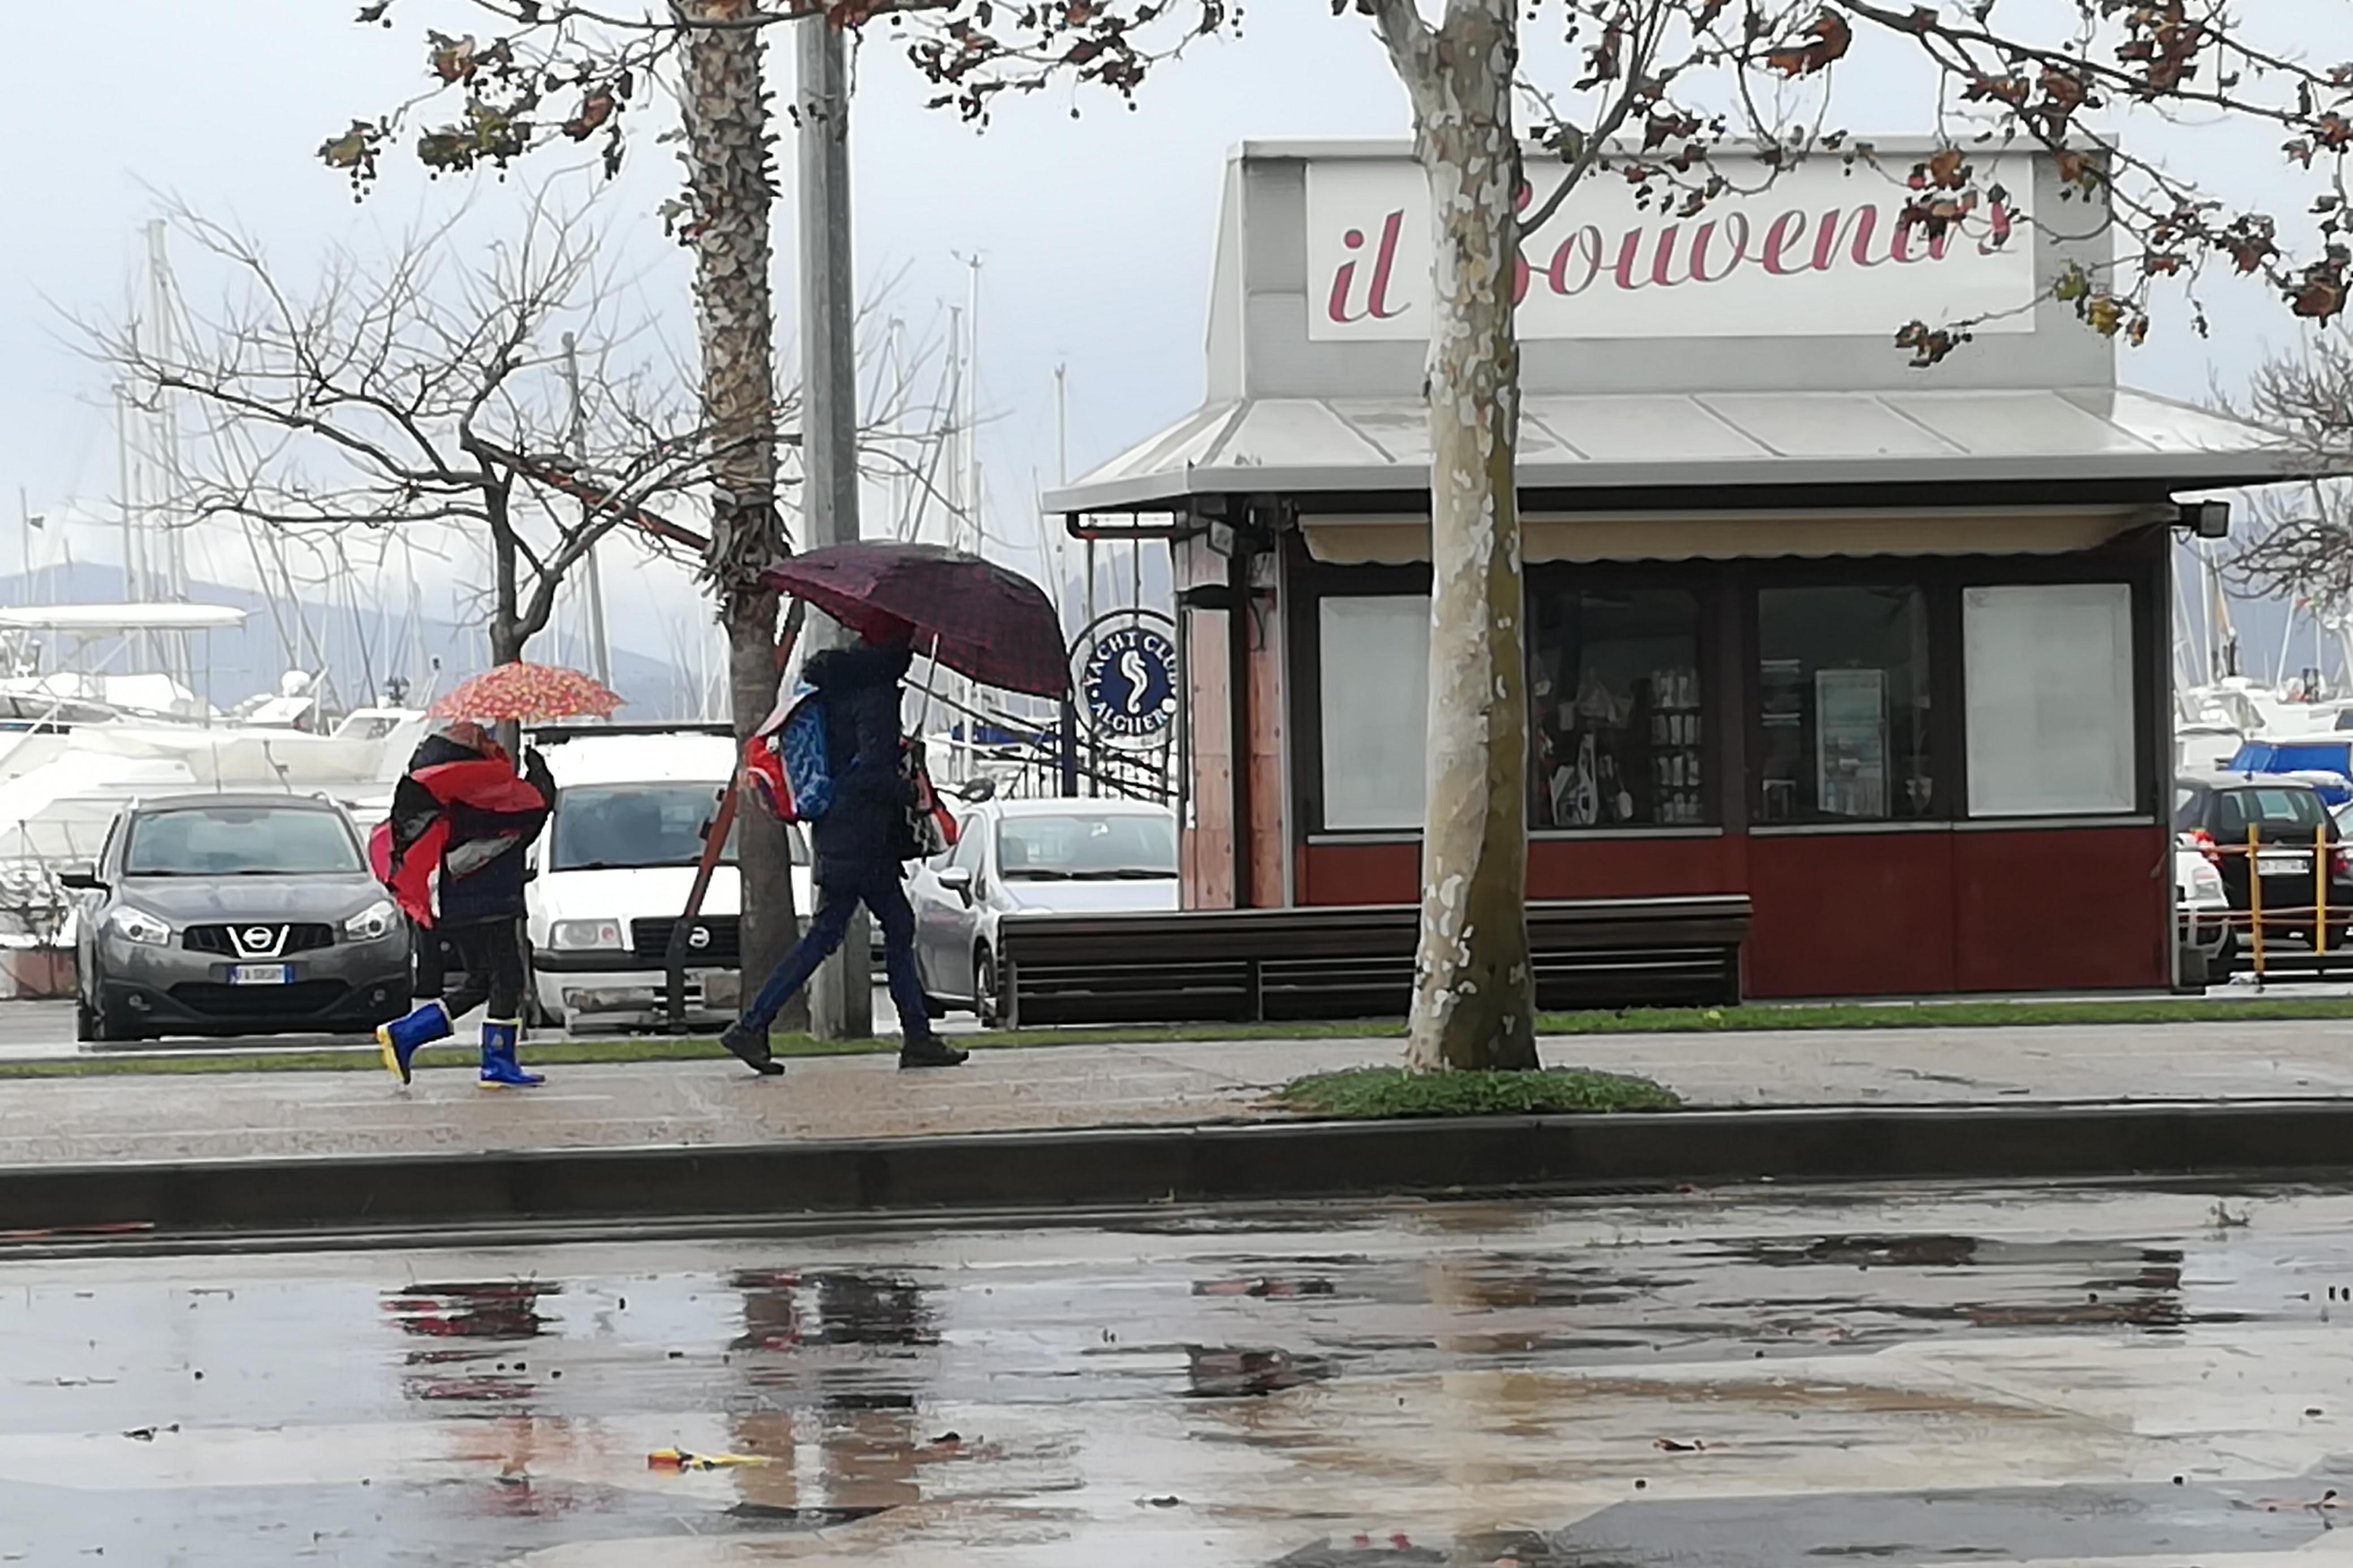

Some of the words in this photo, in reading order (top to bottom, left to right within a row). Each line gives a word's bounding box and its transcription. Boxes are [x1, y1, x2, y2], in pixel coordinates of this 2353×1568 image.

[1329, 208, 1411, 323] il
[1080, 632, 1137, 686] YACHT
[1091, 699, 1173, 734] ALGHER
